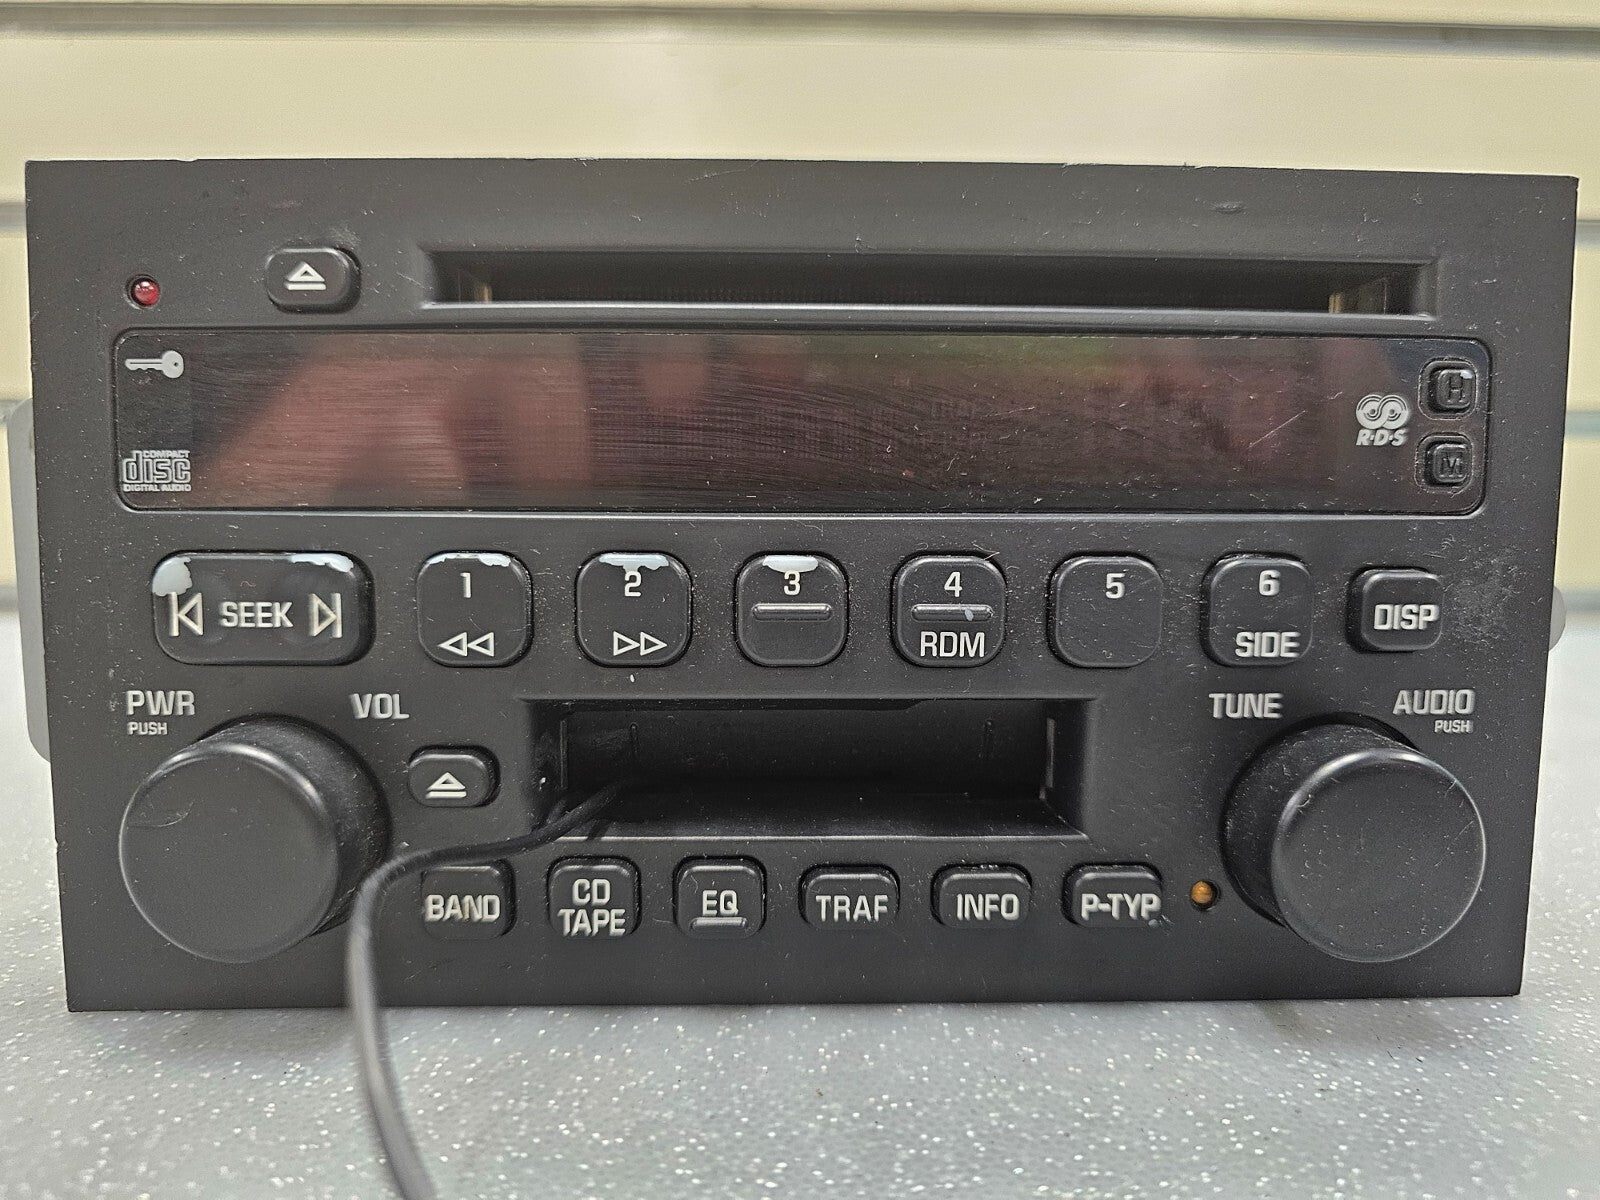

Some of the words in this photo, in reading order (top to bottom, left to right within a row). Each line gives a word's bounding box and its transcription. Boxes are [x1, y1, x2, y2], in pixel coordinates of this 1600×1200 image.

[143, 450, 190, 458] COMPACT
[462, 573, 472, 597] 1
[624, 571, 643, 597] 2
[783, 571, 802, 597] 3
[943, 572, 963, 596] 4
[1105, 573, 1125, 598] 5
[1258, 571, 1280, 596] 6
[221, 602, 293, 628] SEEK
[1373, 604, 1439, 631] DISP
[919, 632, 986, 657] RDM
[1235, 631, 1299, 658] SIDE
[126, 690, 195, 716] PWR
[350, 693, 410, 720] VOL
[1209, 692, 1283, 719] TUNE
[1393, 689, 1475, 715] AUDIO
[128, 721, 168, 736] PUSH
[1434, 720, 1472, 734] PUSH
[572, 878, 611, 905] CD
[701, 889, 739, 917] EQ
[425, 893, 501, 922] BAND
[815, 893, 889, 922] TRAF
[955, 892, 1020, 921] INFO
[1080, 892, 1162, 922] P-TYP
[558, 908, 626, 937] TAPE
